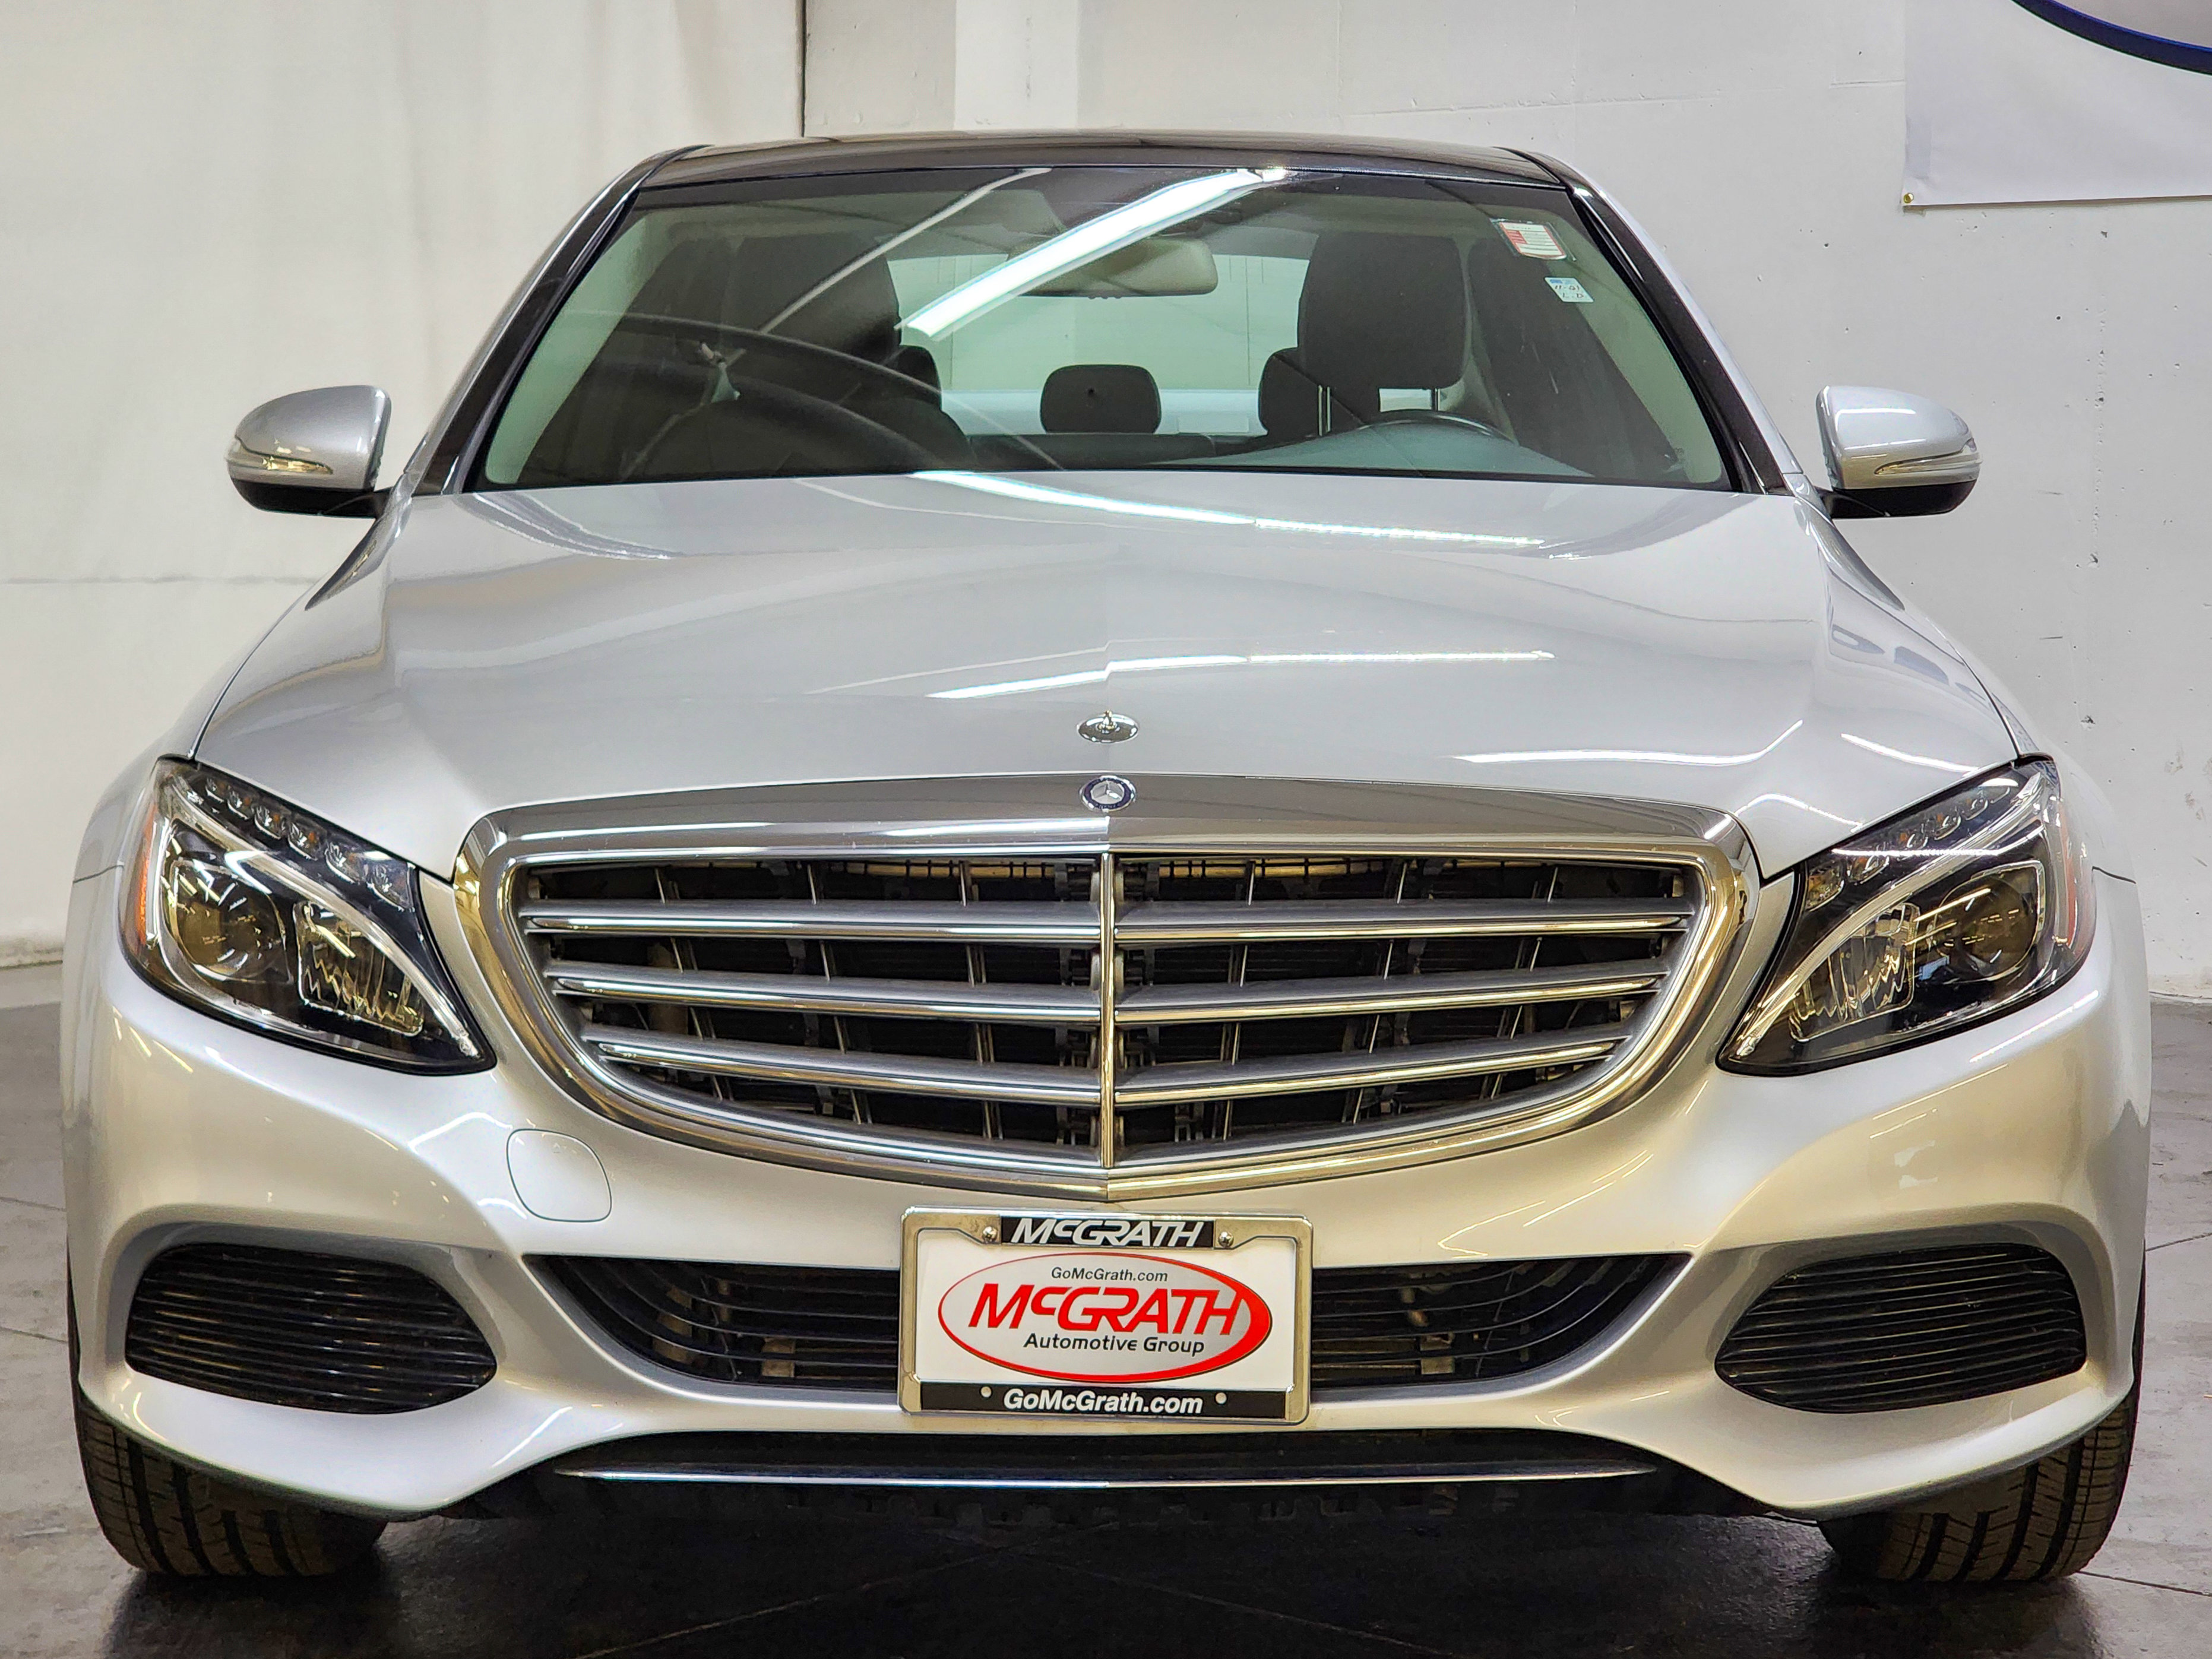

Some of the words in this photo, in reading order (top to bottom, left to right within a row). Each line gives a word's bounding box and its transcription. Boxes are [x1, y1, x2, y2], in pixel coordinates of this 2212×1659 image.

[1050, 1266, 1169, 1283] GoMcGrath.com
[1023, 1332, 1137, 1351] Automotive
[1143, 1336, 1205, 1357] Group
[1004, 1388, 1204, 1414] GoMcGrath.com
